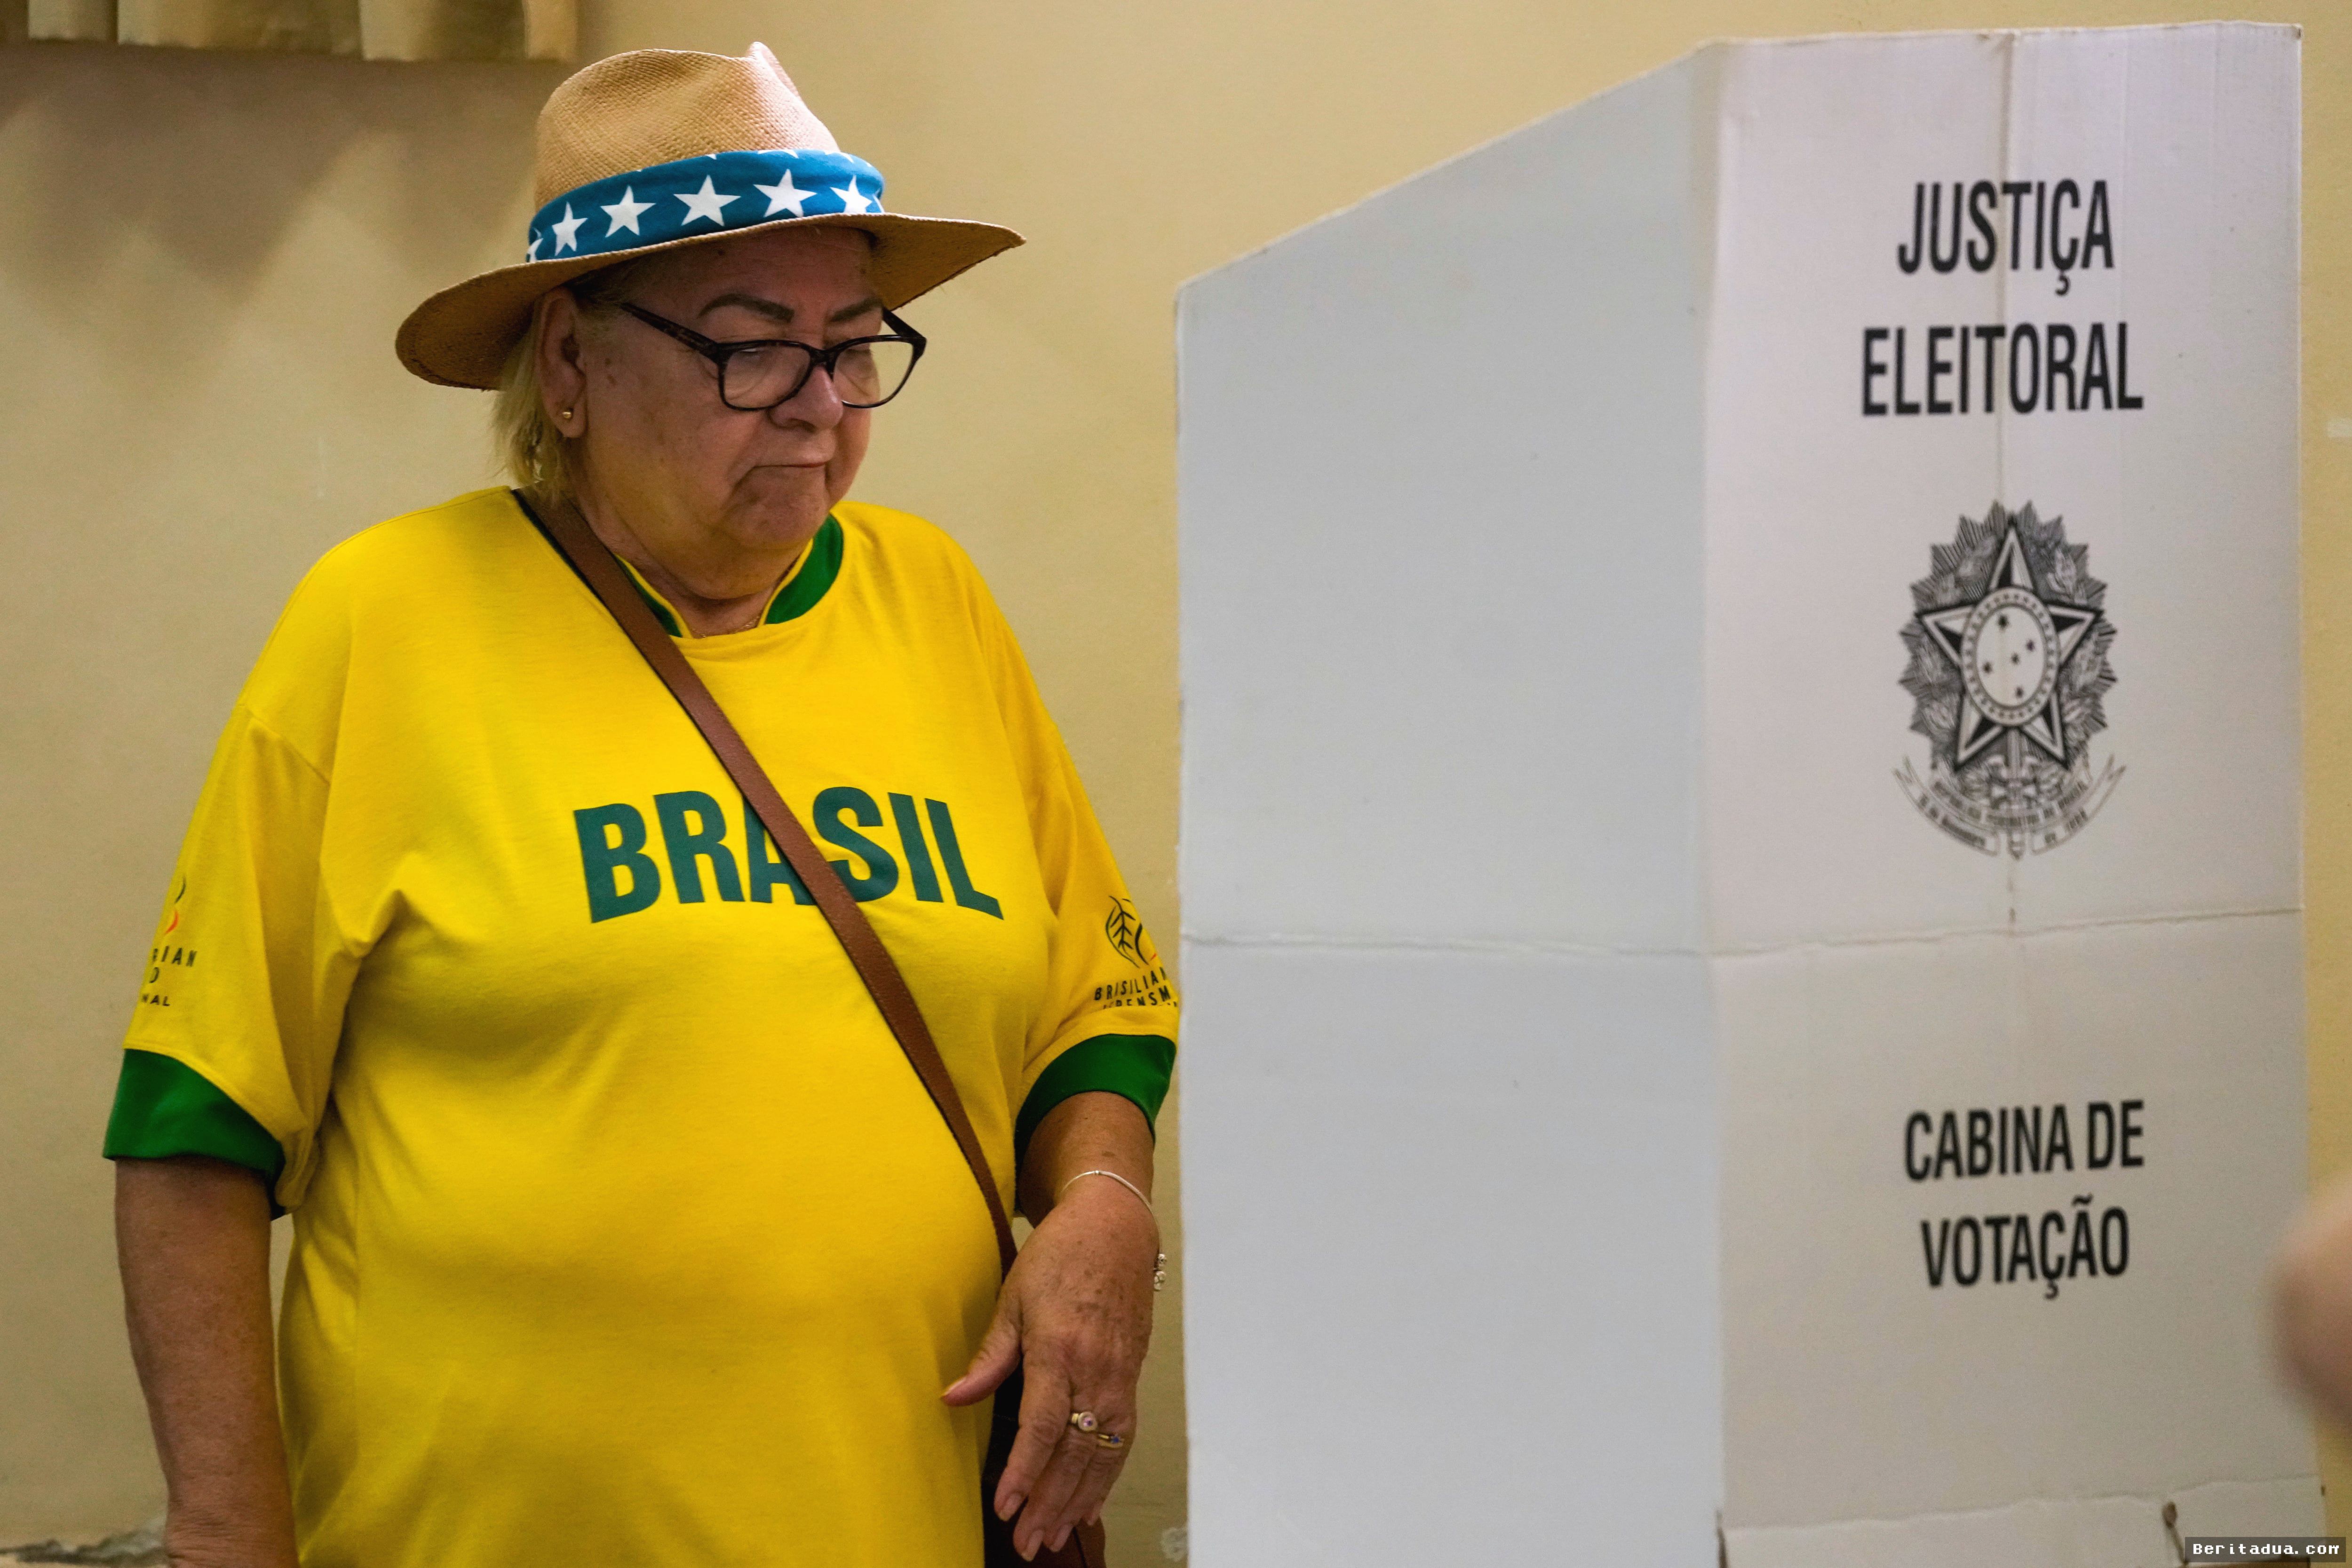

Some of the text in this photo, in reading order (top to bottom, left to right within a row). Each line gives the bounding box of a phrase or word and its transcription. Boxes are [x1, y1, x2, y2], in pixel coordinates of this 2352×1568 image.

[1897, 178, 2114, 296] JUSTIÇA
[1862, 322, 2144, 417] ELEITORAL
[573, 786, 1004, 924] BRASIL
[1905, 1099, 2145, 1182] CABINA DE
[1920, 1193, 2130, 1300] VOTAÇÃO
